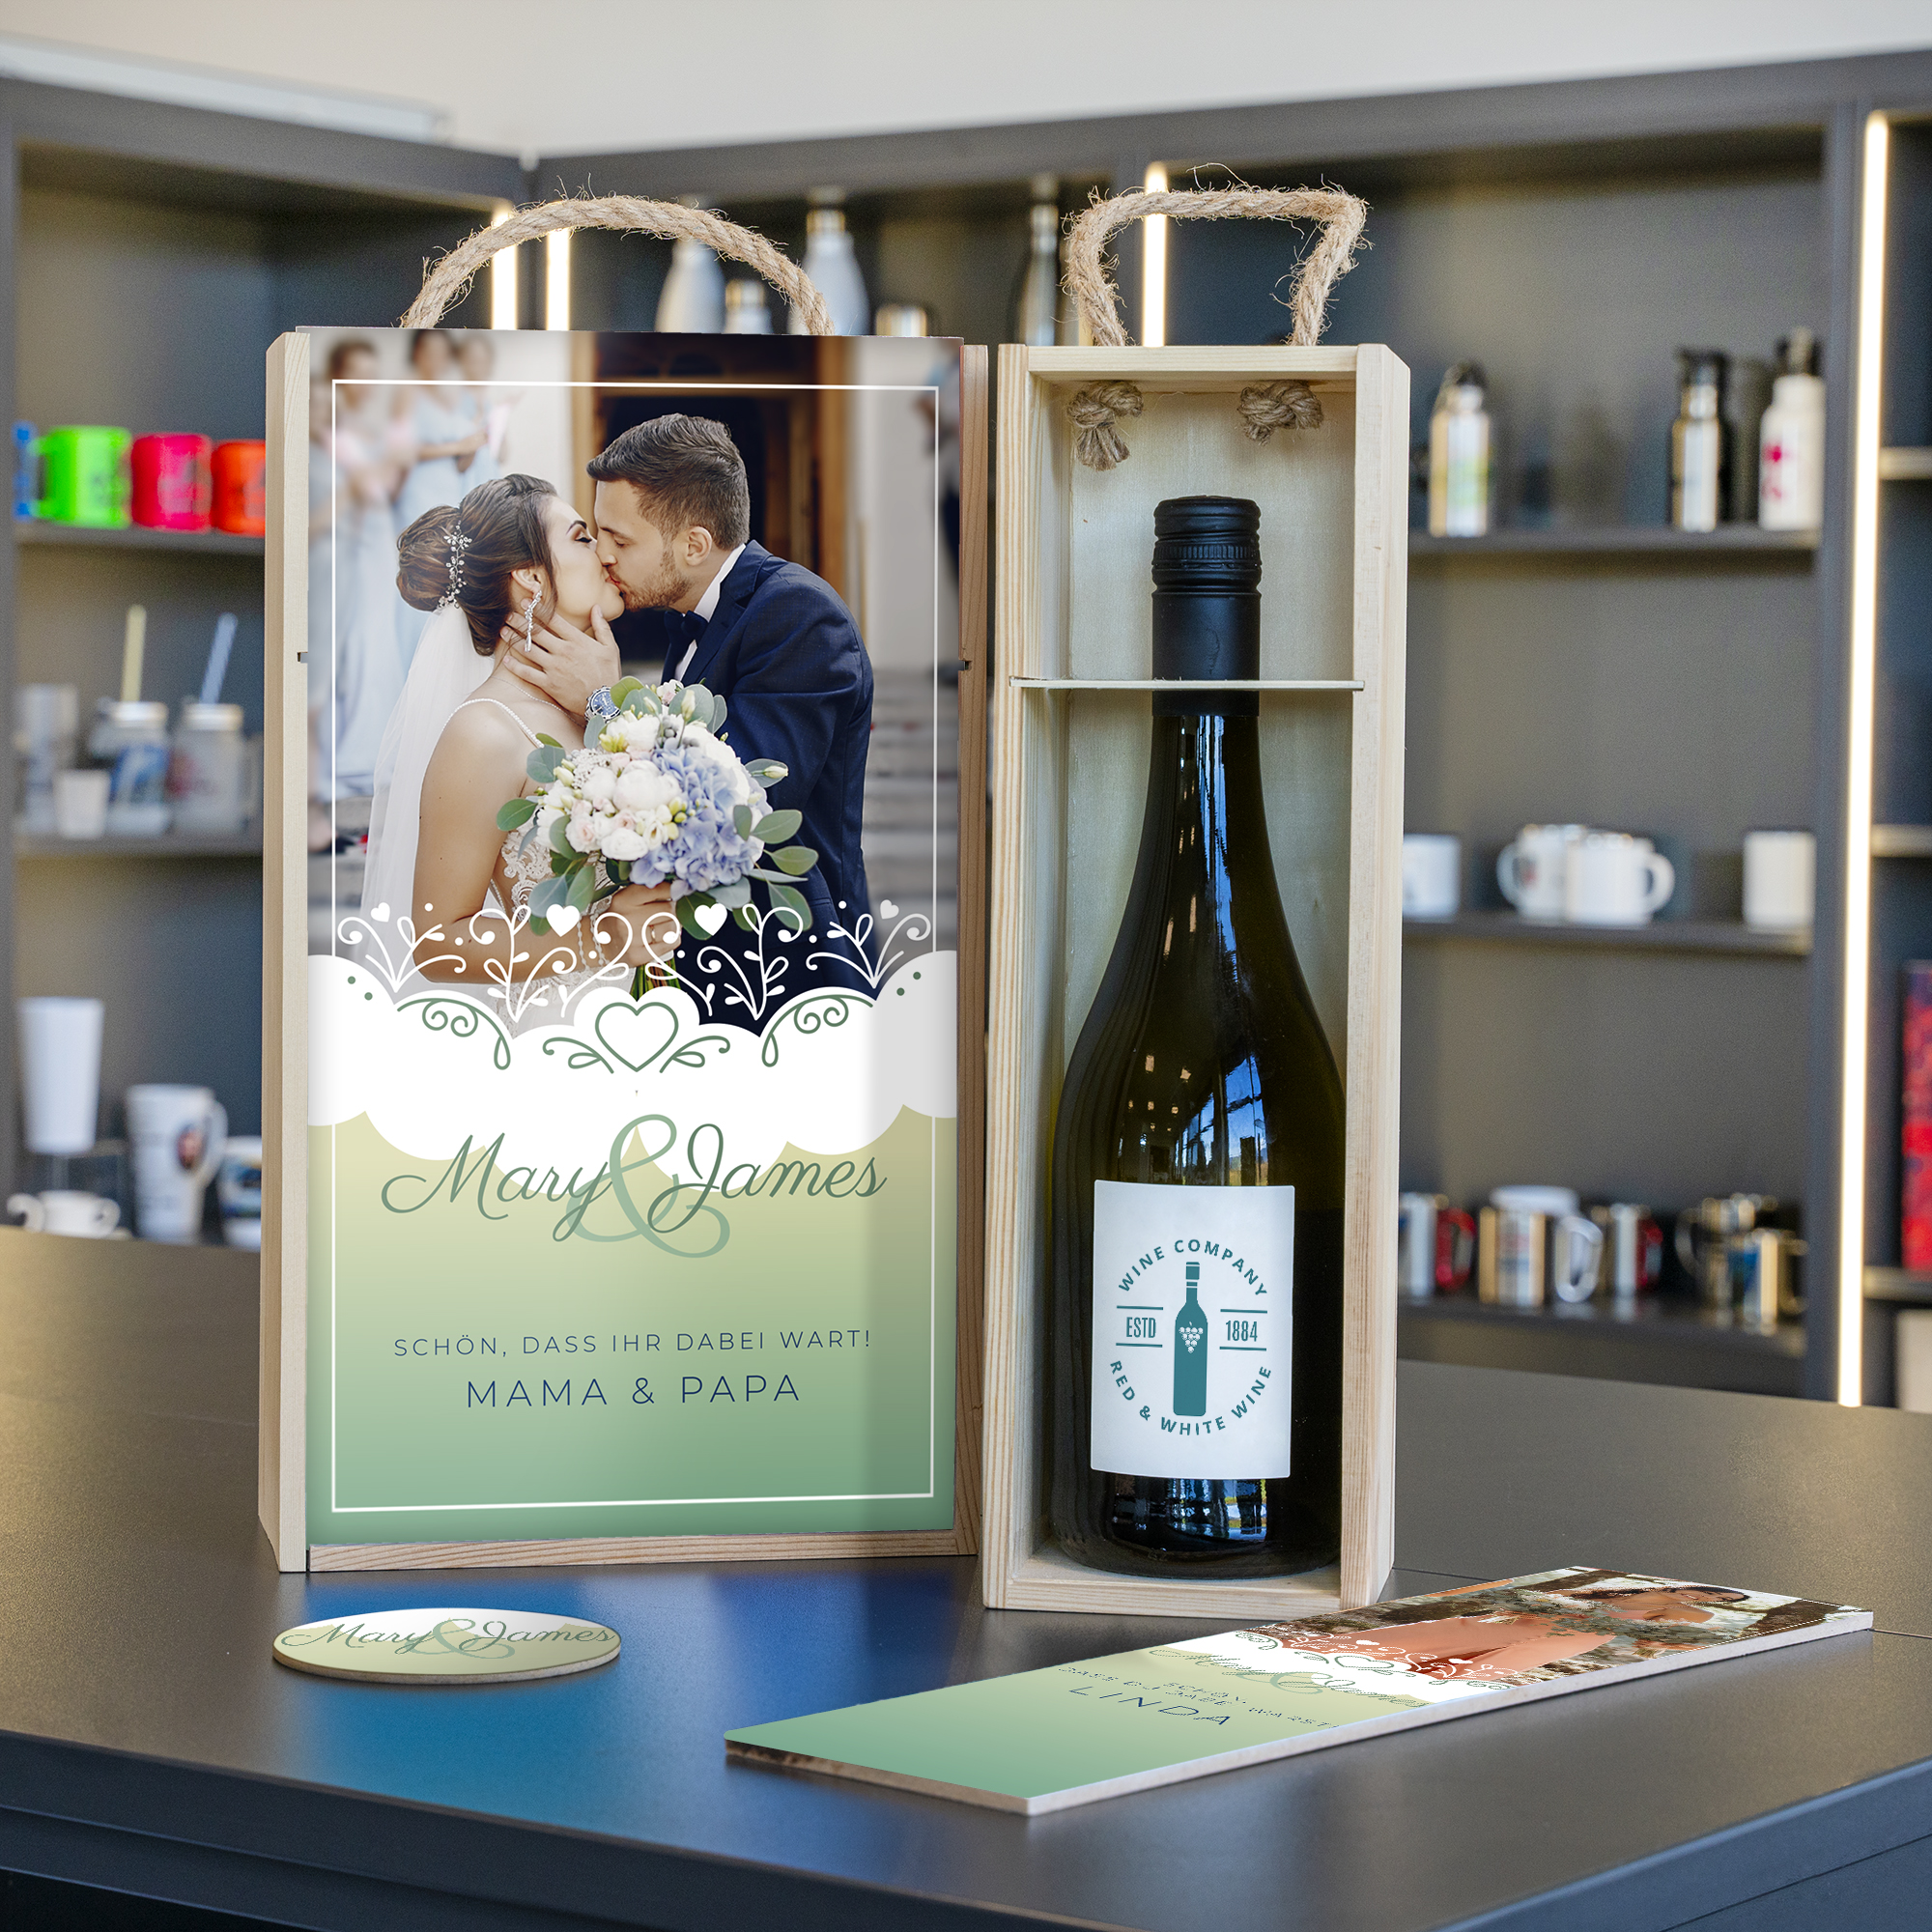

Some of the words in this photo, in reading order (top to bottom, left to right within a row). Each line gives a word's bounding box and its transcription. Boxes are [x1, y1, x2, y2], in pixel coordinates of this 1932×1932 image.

[1118, 1246, 1165, 1292] WINE
[1174, 1238, 1267, 1296] COMPANY
[394, 1334, 506, 1358] SCHÖN,
[523, 1335, 597, 1354] DASS
[612, 1334, 661, 1352] IHR
[677, 1332, 764, 1351] DABEI
[780, 1329, 869, 1349] WART!
[1126, 1317, 1157, 1338] ESTD
[1225, 1320, 1258, 1342] 1884
[468, 1378, 608, 1407] MAMA
[632, 1377, 655, 1405] &
[682, 1374, 800, 1404] PAPA
[1110, 1360, 1136, 1401] RED
[1139, 1406, 1151, 1421] &
[1161, 1416, 1226, 1435] WHITE
[1231, 1366, 1271, 1419] WINE
[1068, 1686, 1231, 1725] LINDA
